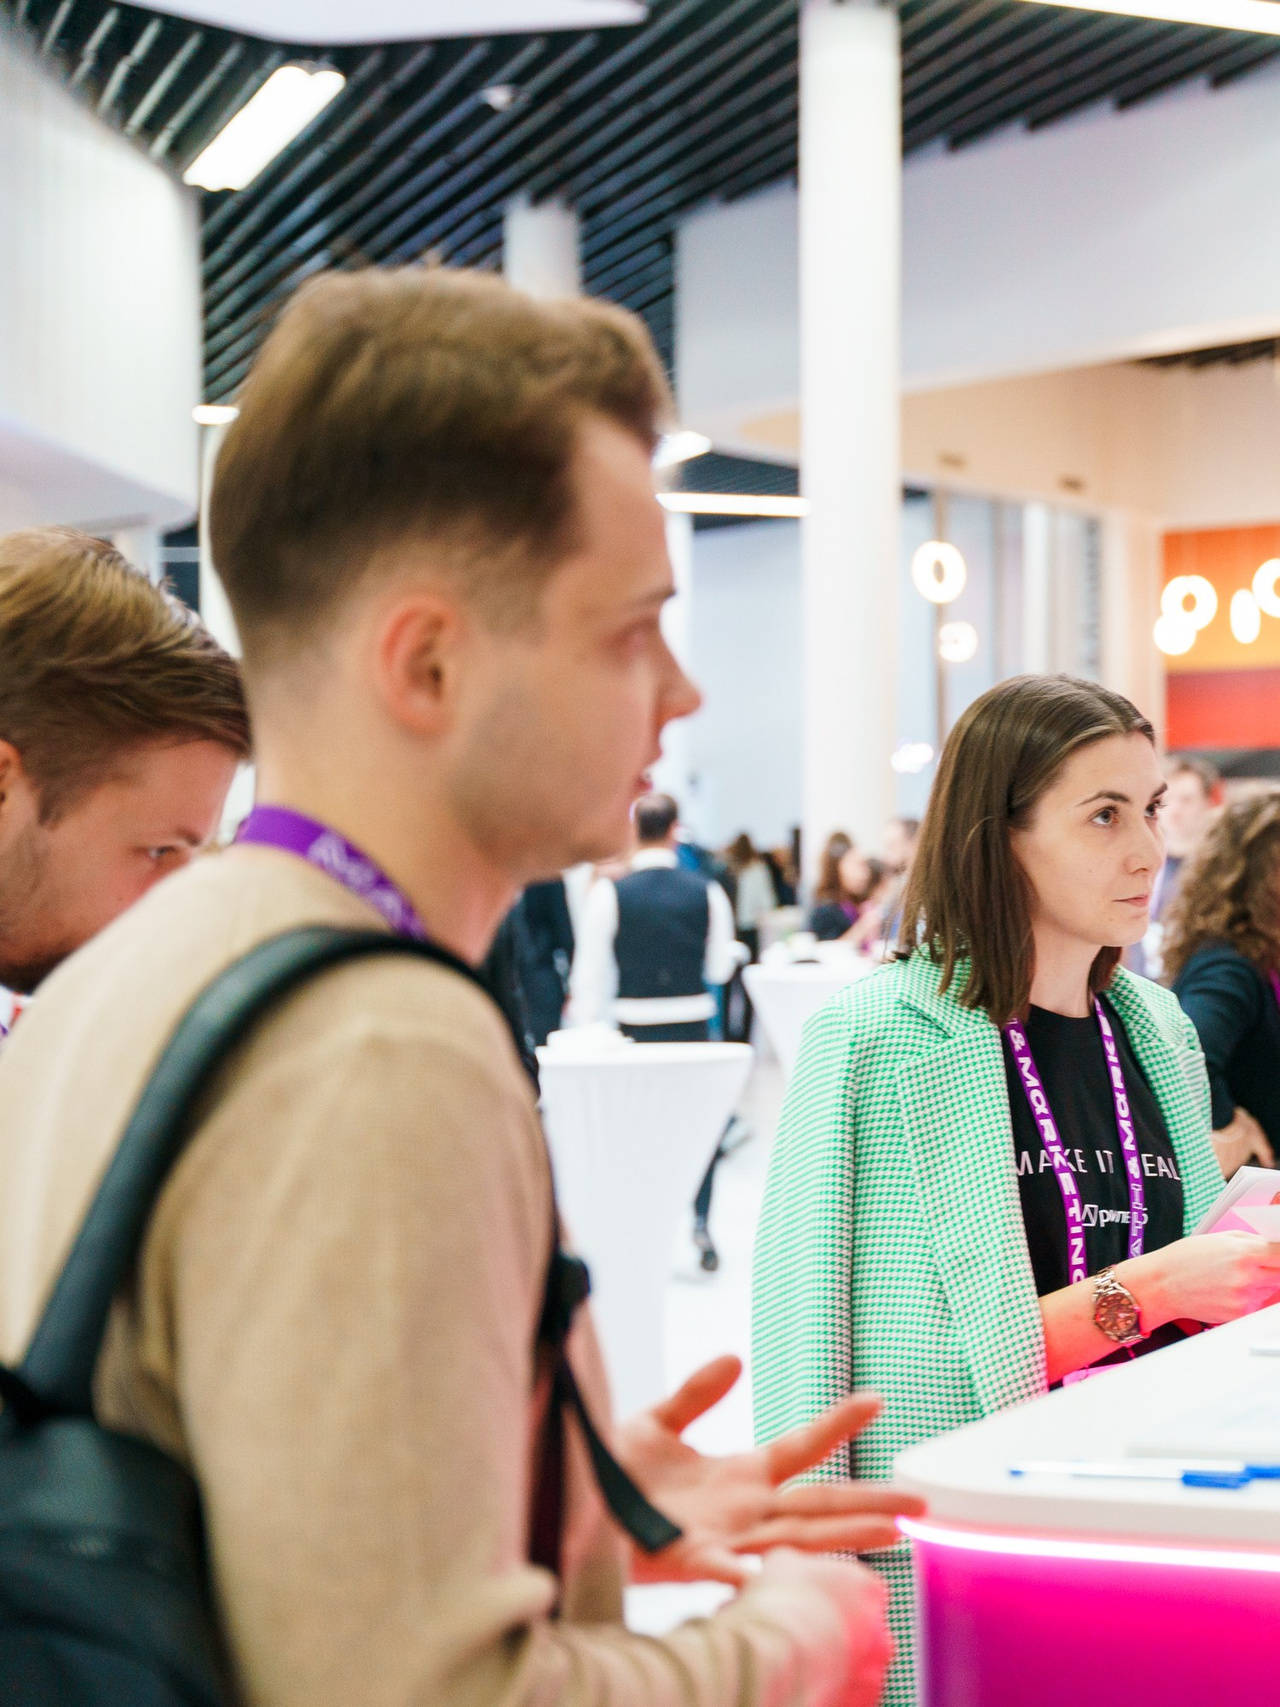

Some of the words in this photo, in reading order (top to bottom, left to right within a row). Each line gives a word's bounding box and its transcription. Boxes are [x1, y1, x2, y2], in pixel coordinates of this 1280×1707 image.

[1009, 1028, 1027, 1052] &
[1094, 1149, 1115, 1174] IT
[1140, 1153, 1182, 1181] EAL
